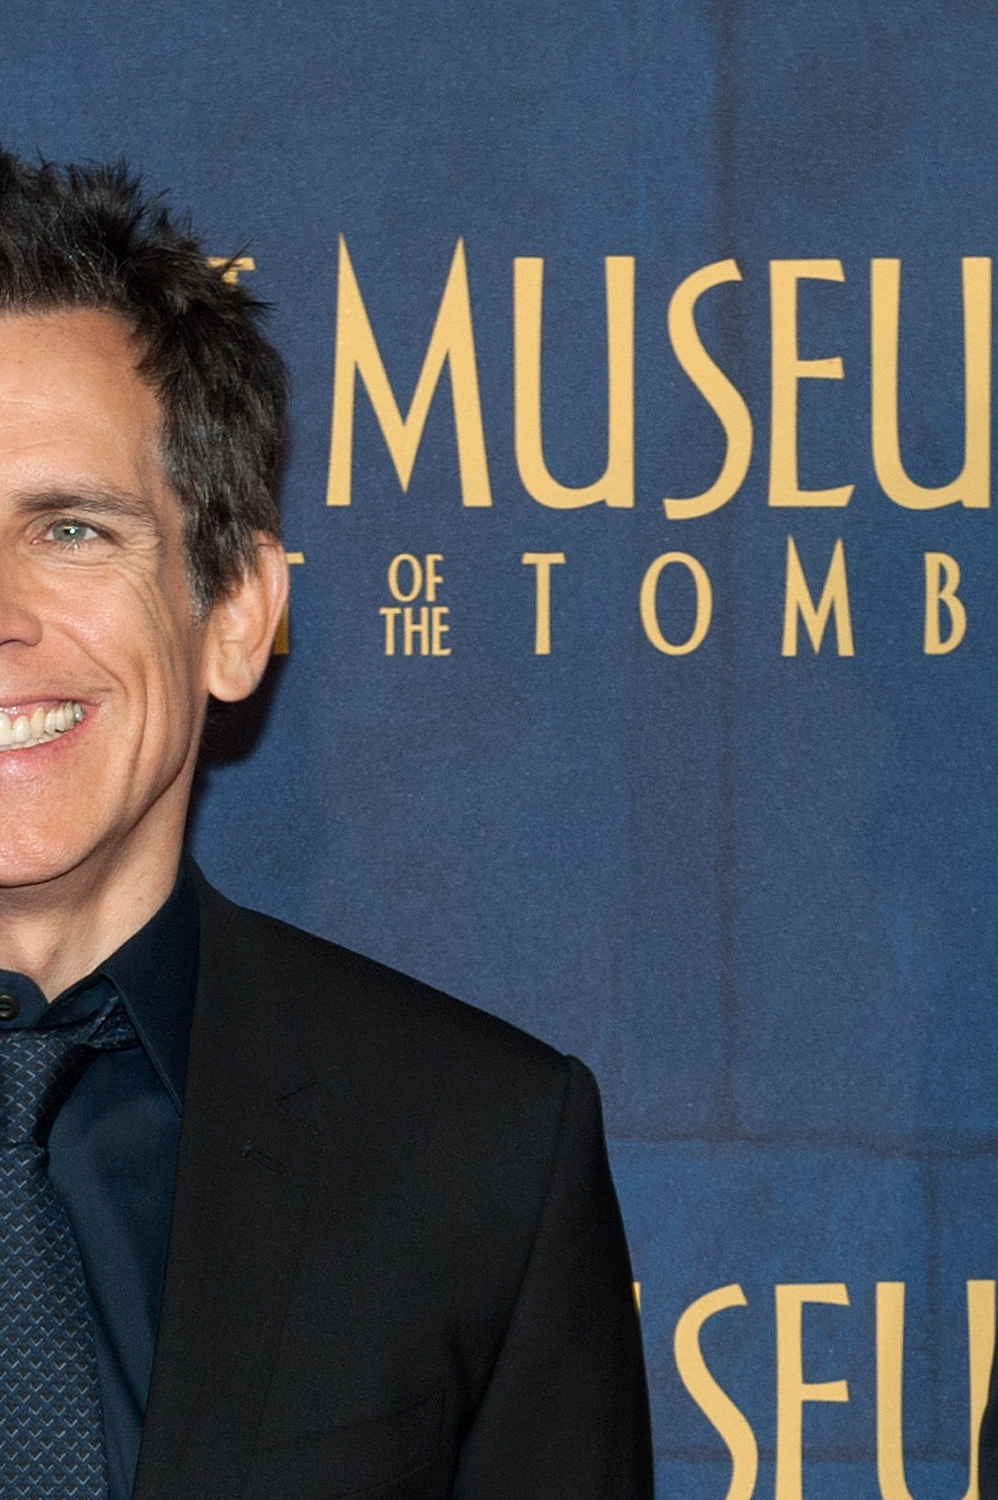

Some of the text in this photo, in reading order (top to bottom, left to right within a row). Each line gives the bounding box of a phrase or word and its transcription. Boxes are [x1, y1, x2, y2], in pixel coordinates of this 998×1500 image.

[325, 232, 993, 521] MUSEU
[388, 553, 444, 603] OF
[521, 535, 967, 657] TOMB
[378, 606, 452, 657] THE
